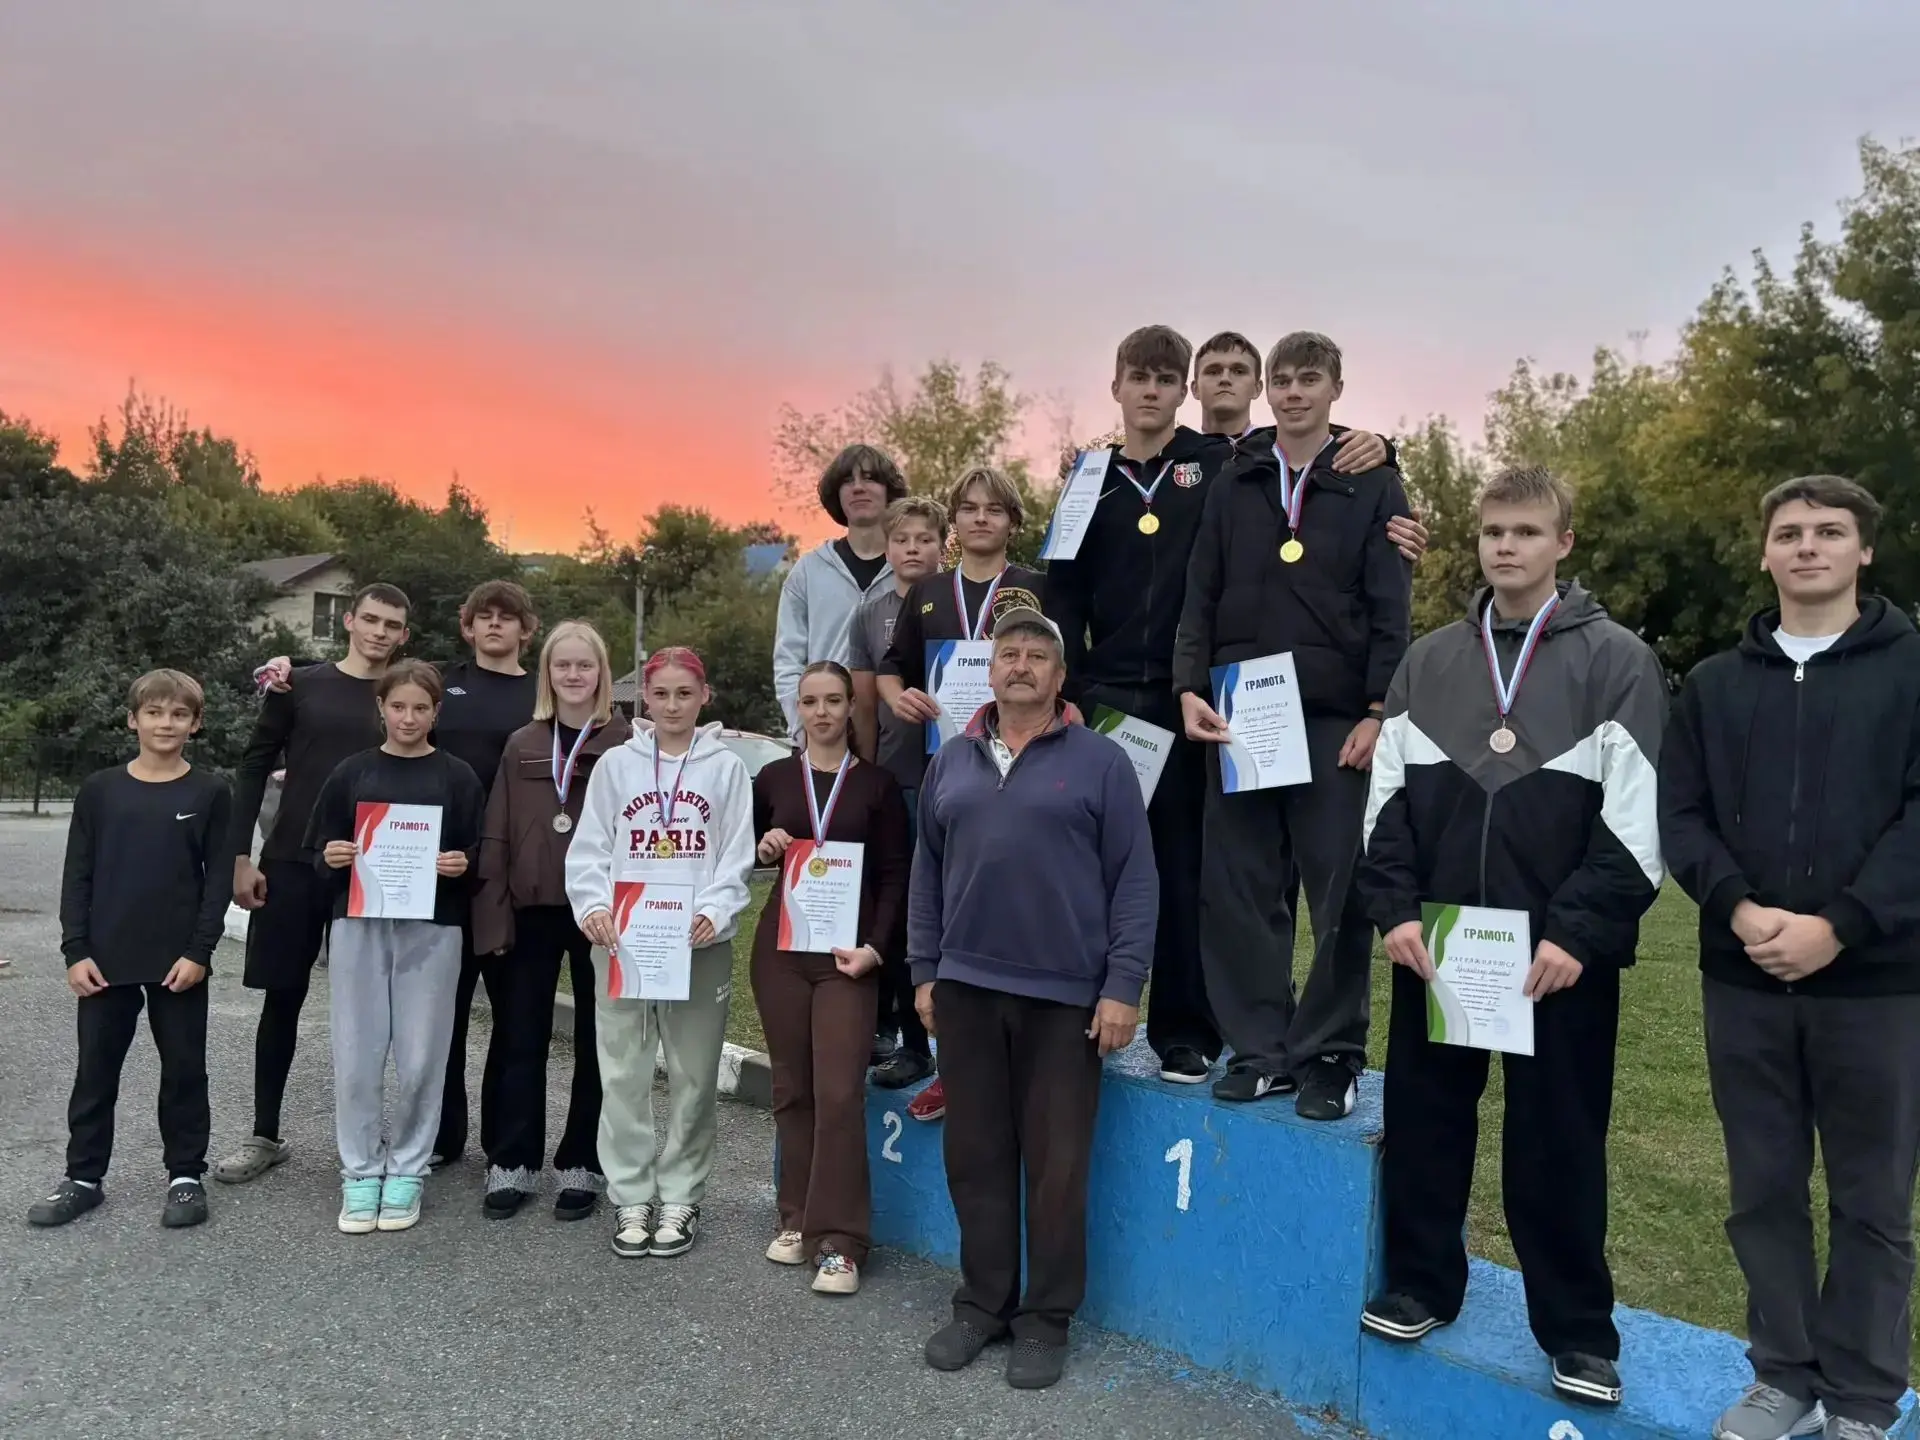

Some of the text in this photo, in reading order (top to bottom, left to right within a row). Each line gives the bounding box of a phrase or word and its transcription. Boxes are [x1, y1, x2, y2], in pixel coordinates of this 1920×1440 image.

[957, 657, 991, 667] ГРАМОТ
[1244, 674, 1286, 692] ГРАМОТА
[1120, 730, 1159, 753] ГРАМОТА
[622, 790, 712, 824] MONTARTRE
[389, 820, 430, 832] ГРАМОТА
[629, 829, 706, 852] PARIS
[644, 900, 683, 911] ГРАМОТА
[1463, 927, 1516, 943] ГРАМОТА
[882, 1110, 902, 1163] 2
[1165, 1138, 1193, 1213] 1
